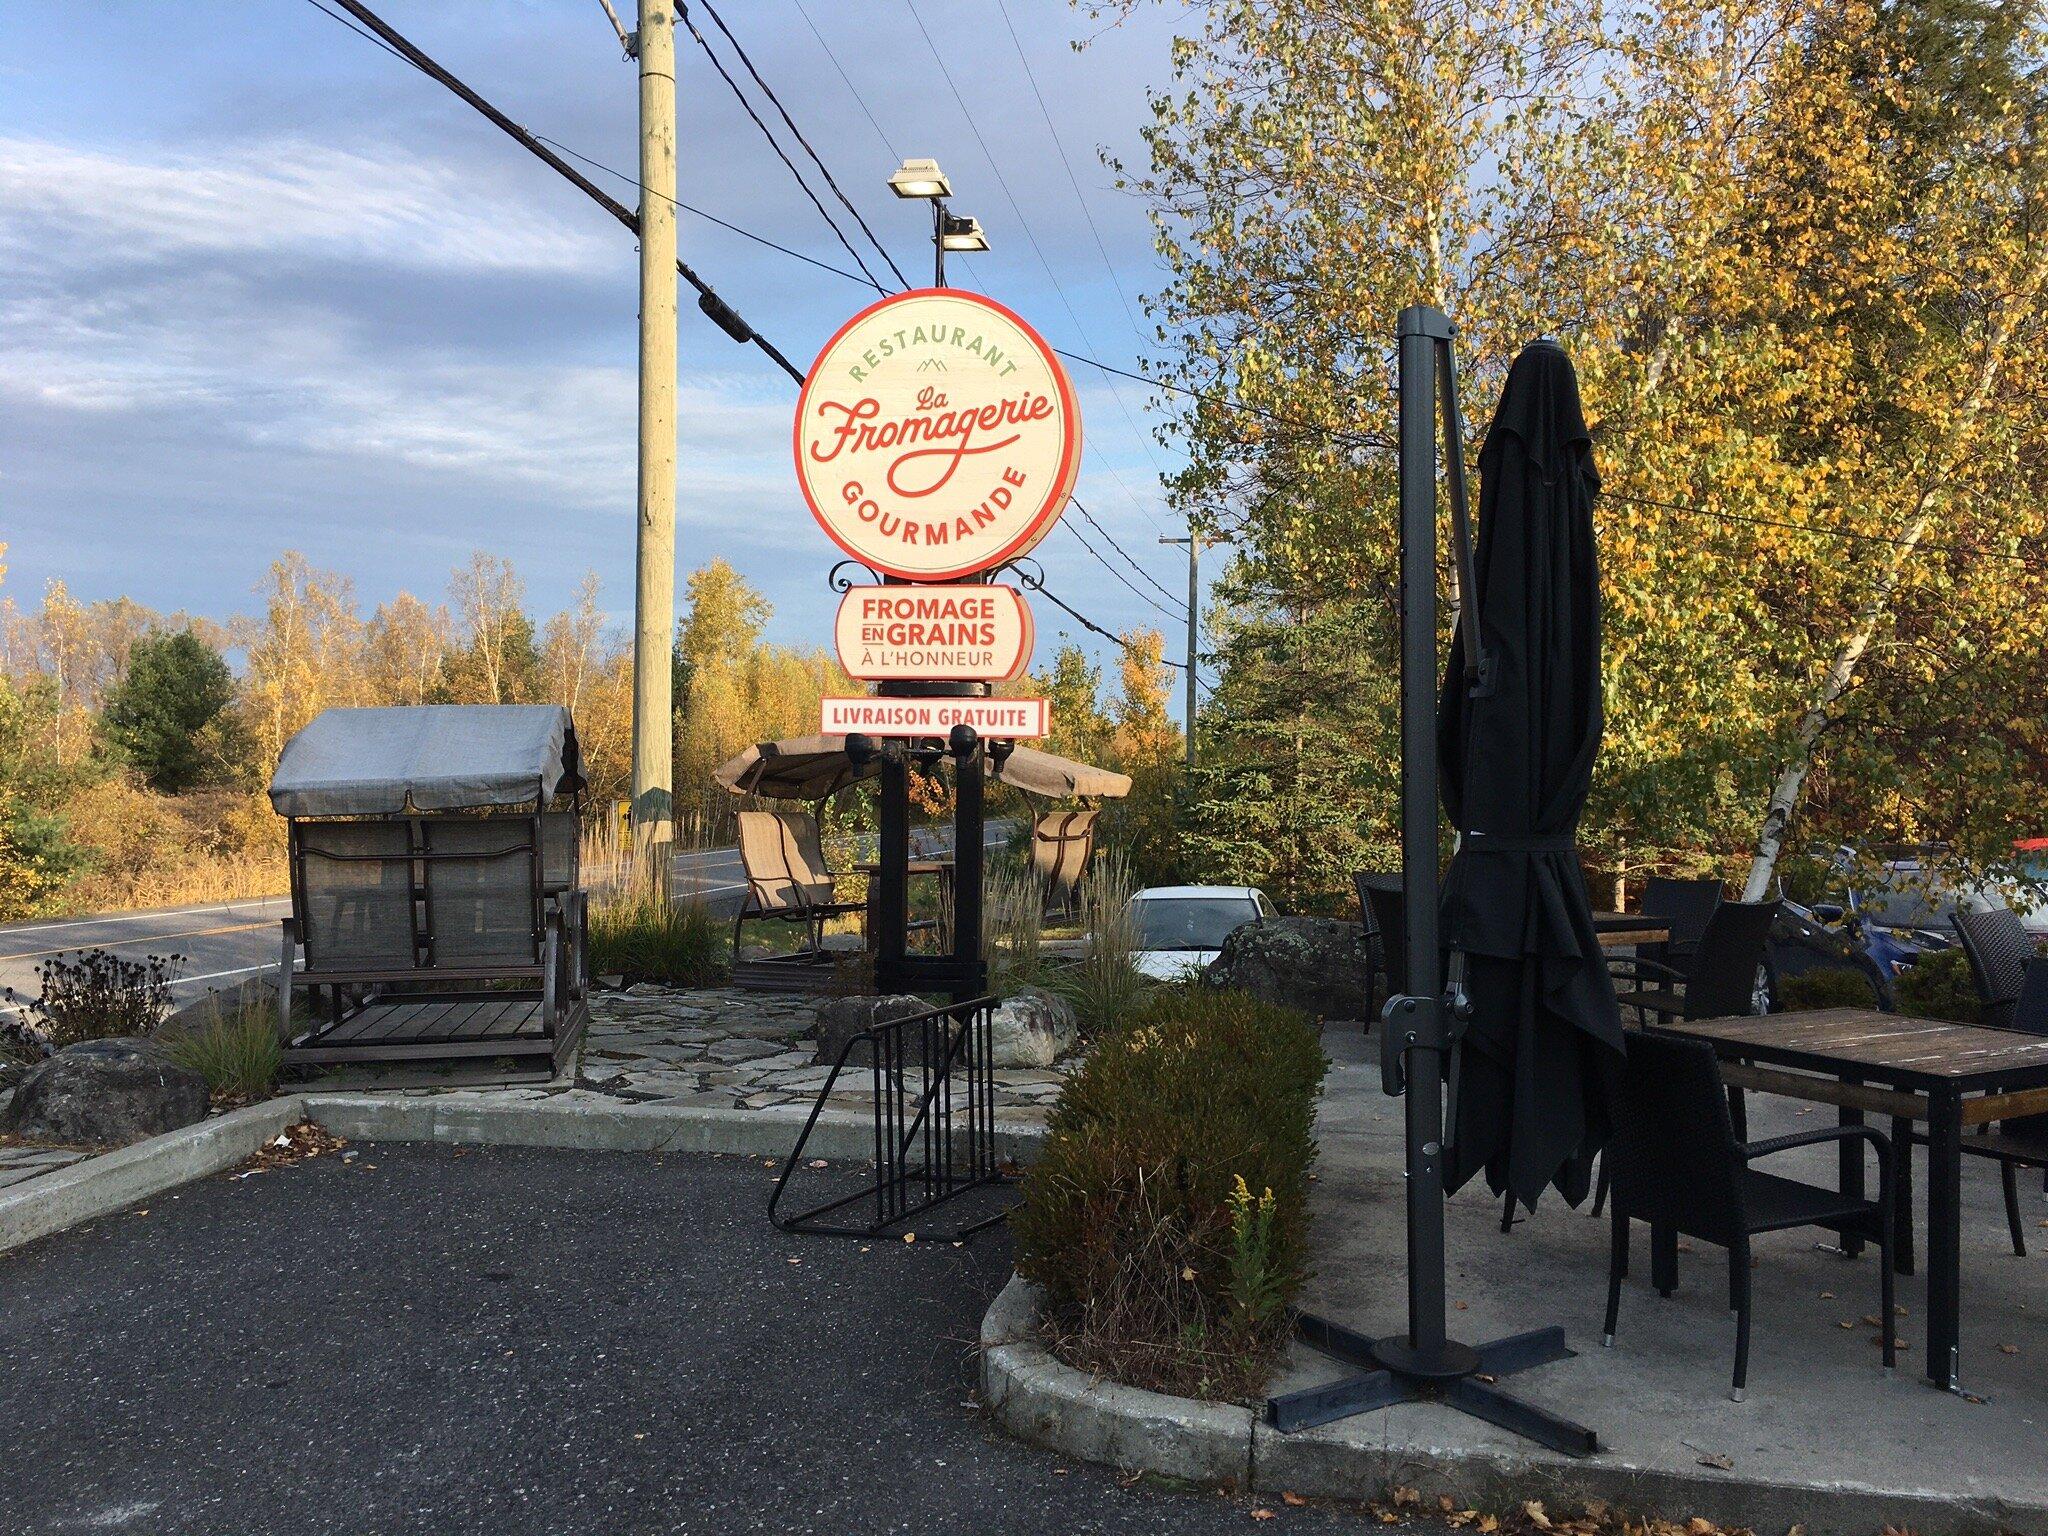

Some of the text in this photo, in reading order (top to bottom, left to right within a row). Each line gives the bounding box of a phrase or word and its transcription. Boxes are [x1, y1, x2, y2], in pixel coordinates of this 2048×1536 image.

[848, 324, 1017, 383] RESTAURANT
[916, 385, 949, 411] La
[811, 391, 1054, 498] Fromagerie
[842, 466, 1026, 545] GOURMANDE
[862, 598, 995, 619] FROMAGE
[861, 623, 995, 646] EN GRAINS
[861, 648, 993, 666] À L'HONNEUR
[833, 707, 1026, 727] LIVRAISON GRATUITE
